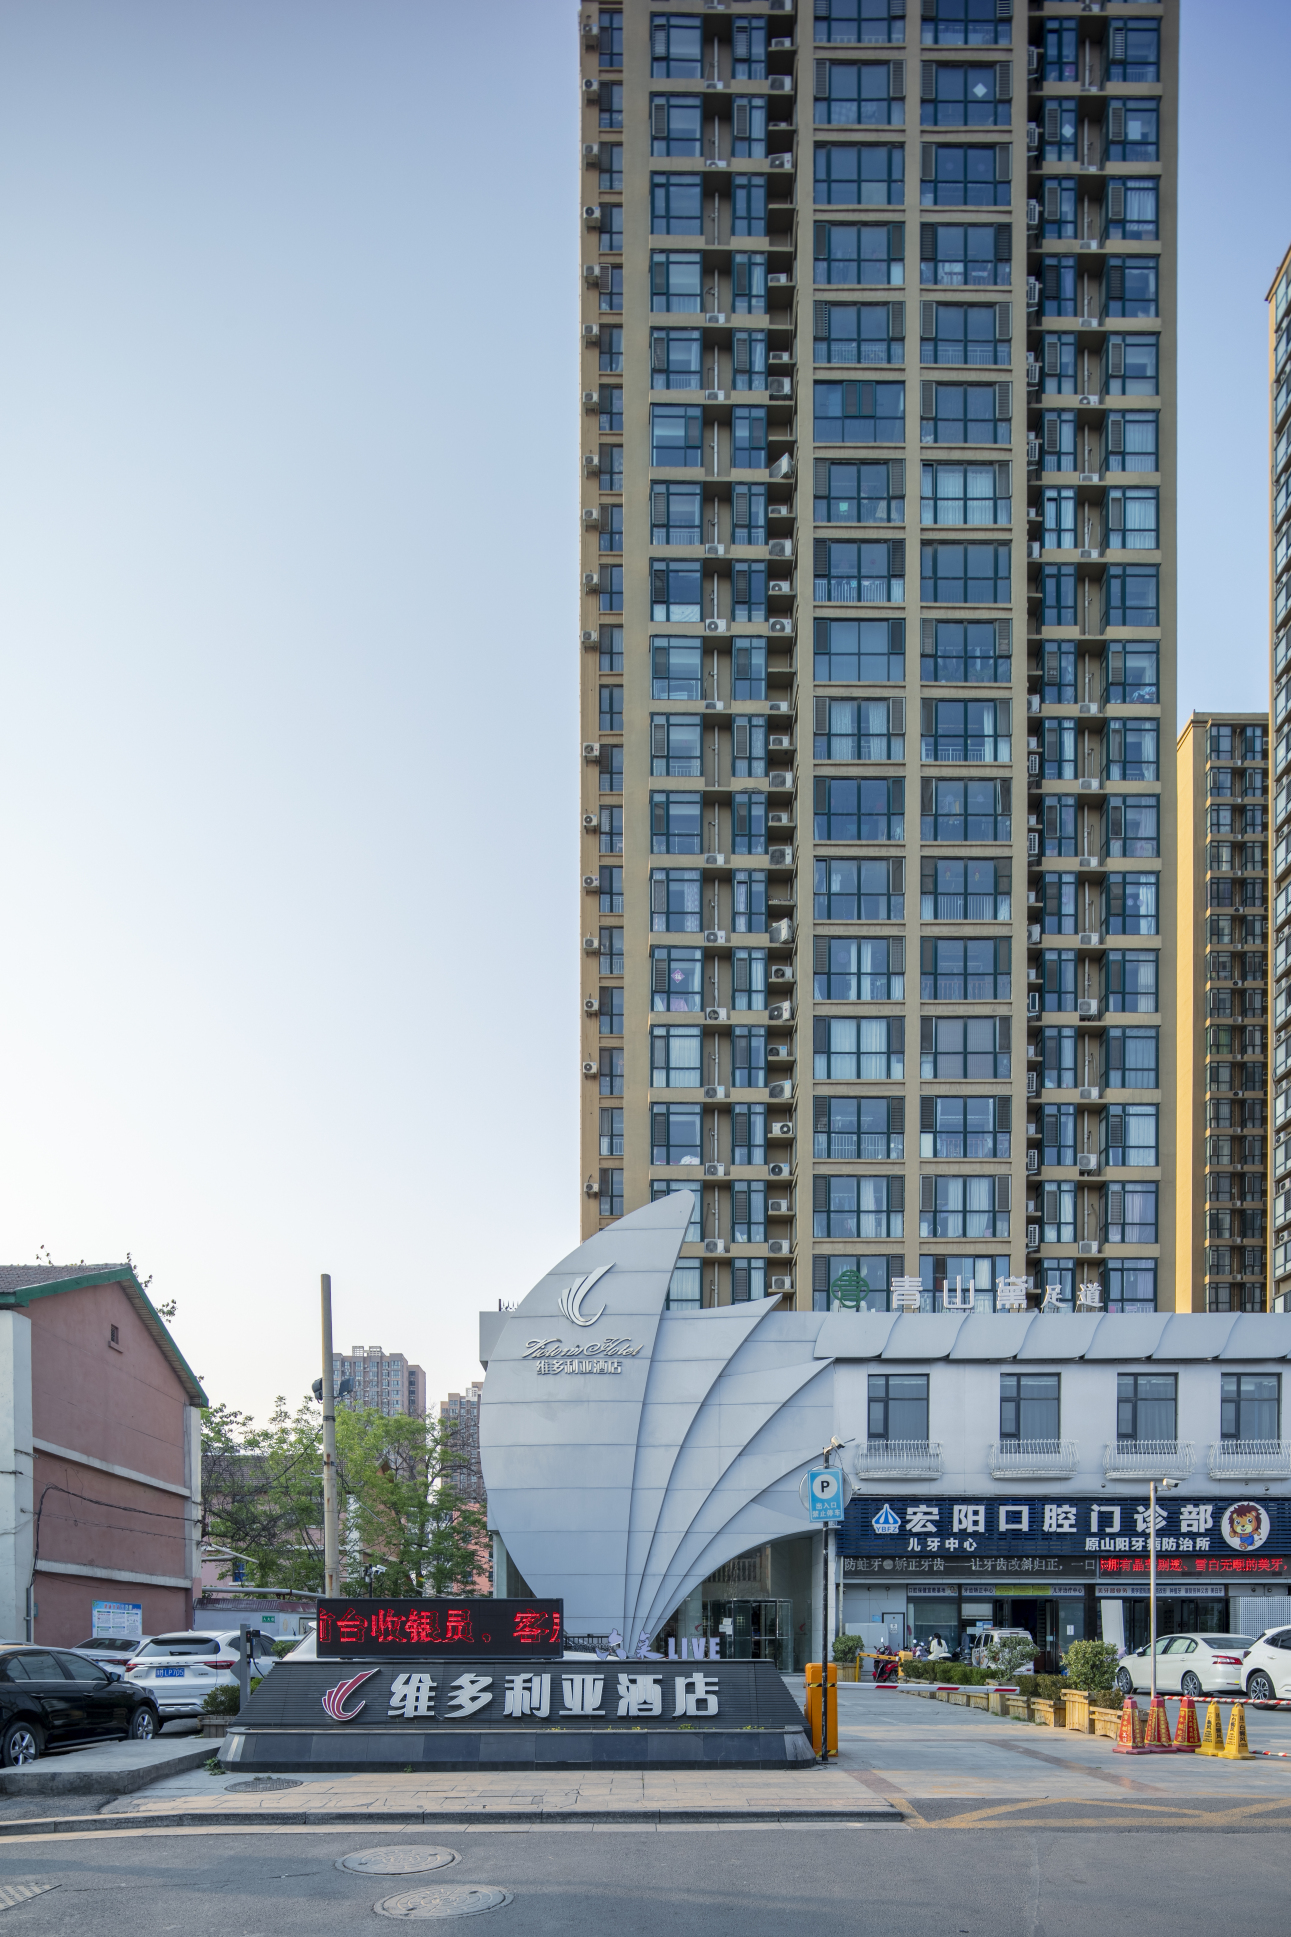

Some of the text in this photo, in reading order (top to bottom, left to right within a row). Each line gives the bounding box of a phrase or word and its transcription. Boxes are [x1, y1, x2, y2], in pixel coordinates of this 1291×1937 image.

[536, 1359, 622, 1375] 维多利亚酒店
[821, 1480, 830, 1493] P
[812, 1509, 841, 1517] 禁止停车
[905, 1504, 1213, 1533] 宏阳口腔门诊部
[875, 1525, 898, 1533] YBFZ
[907, 1537, 978, 1551] 儿牙中心
[668, 1637, 721, 1659] LIVE
[387, 1672, 719, 1718] 维多利亚酒店
